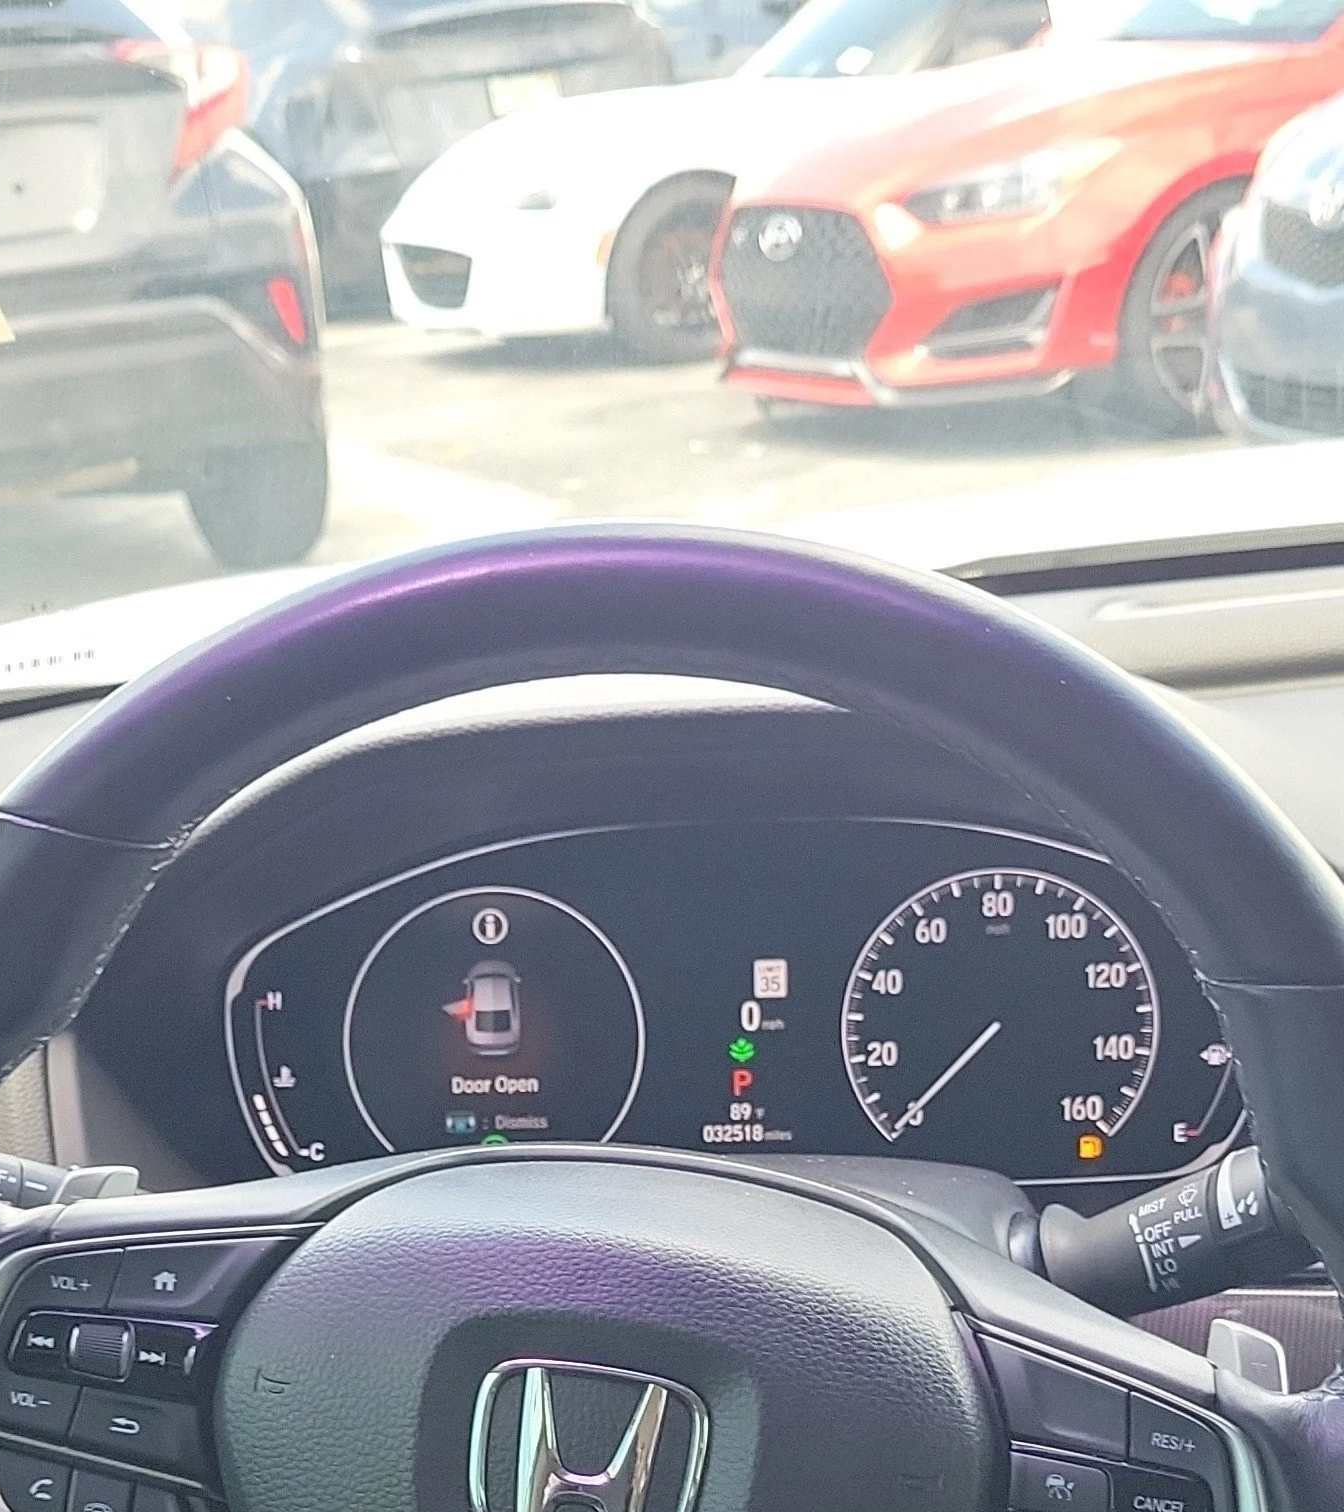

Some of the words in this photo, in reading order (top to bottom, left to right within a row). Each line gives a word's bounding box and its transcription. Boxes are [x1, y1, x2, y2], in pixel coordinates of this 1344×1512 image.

[981, 891, 1015, 917] 80
[914, 917, 948, 943] 60
[1045, 913, 1088, 939] 100
[759, 976, 781, 992] 35
[871, 968, 903, 994] 40
[1084, 963, 1127, 988] 120
[266, 990, 282, 1011] H
[740, 1000, 761, 1031] 0
[866, 1040, 899, 1066] 20
[1093, 1034, 1136, 1060] 140
[451, 1075, 491, 1094] Door
[494, 1075, 540, 1094] Open
[732, 1068, 753, 1097] P
[729, 1102, 753, 1120] 89
[1060, 1095, 1104, 1121] 160
[702, 1124, 763, 1142] 032518
[1173, 1122, 1188, 1143] E
[309, 1141, 325, 1161] C
[1138, 1197, 1167, 1217] MIST
[1173, 1206, 1203, 1225] PULL
[1144, 1220, 1173, 1243] OFF
[1150, 1238, 1176, 1258] INT
[1155, 1258, 1178, 1275] LO
